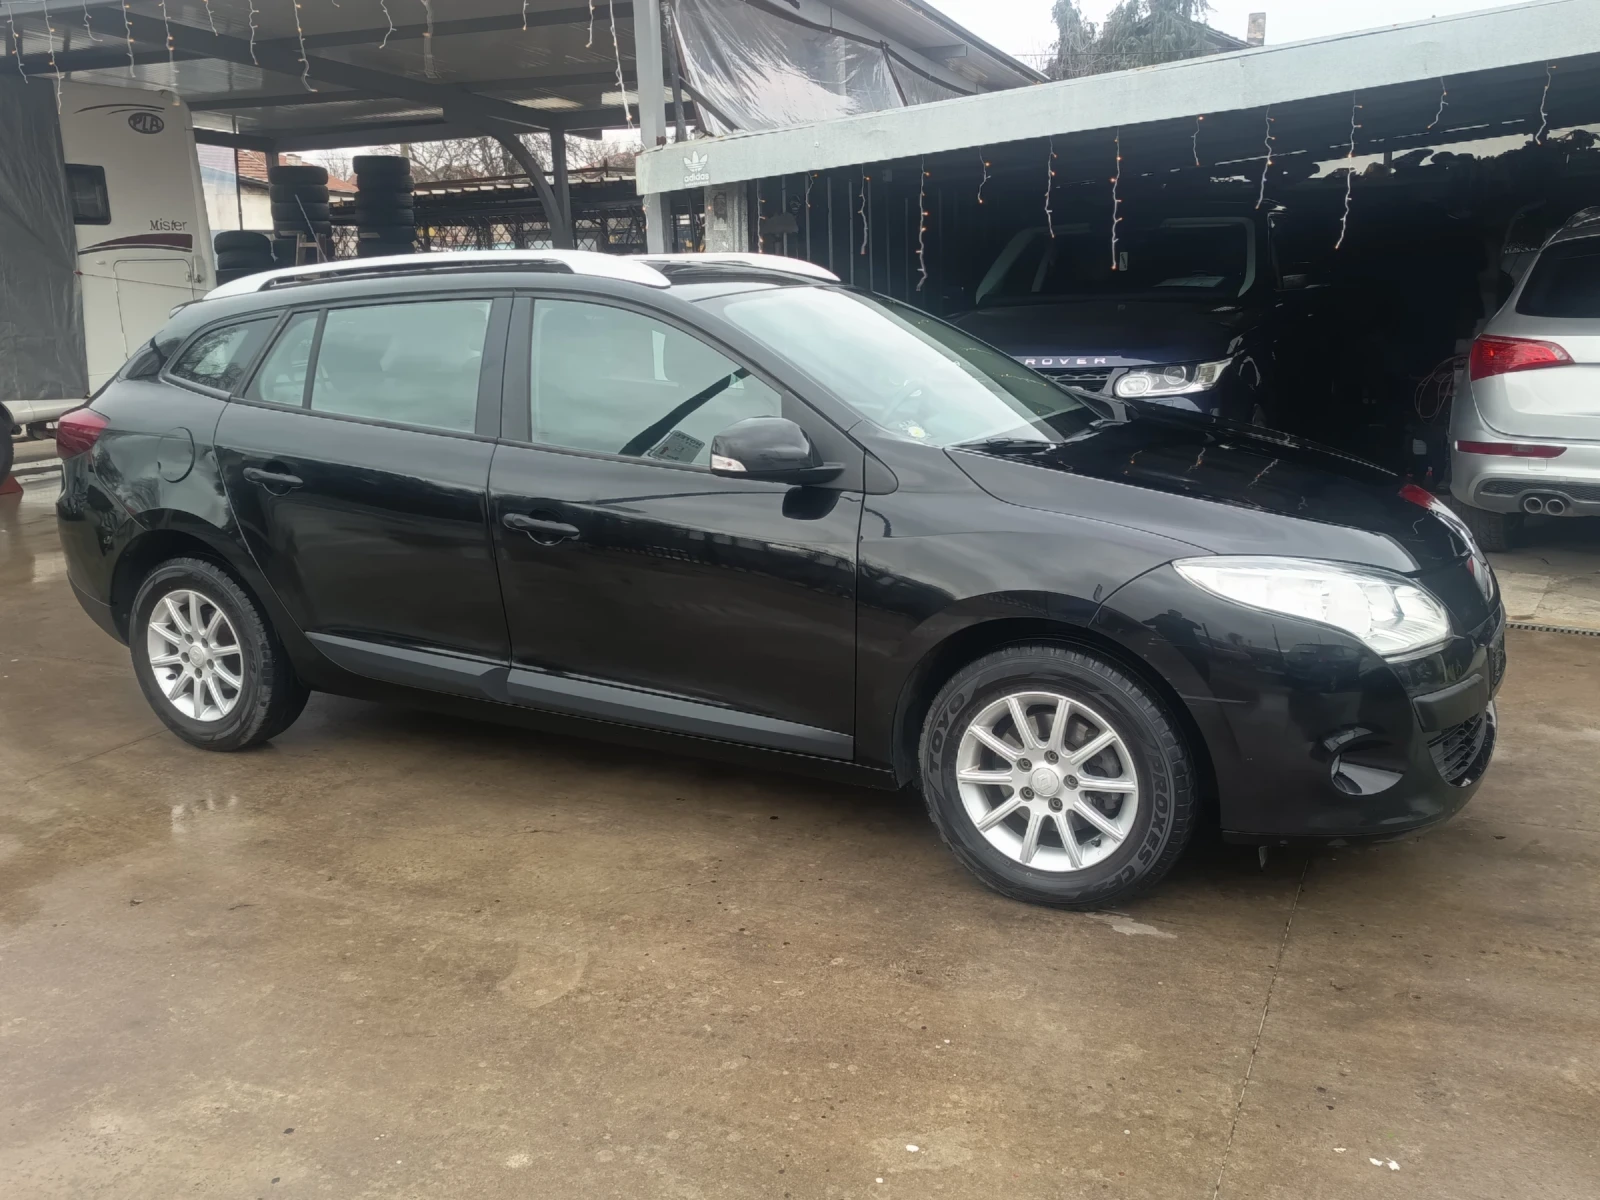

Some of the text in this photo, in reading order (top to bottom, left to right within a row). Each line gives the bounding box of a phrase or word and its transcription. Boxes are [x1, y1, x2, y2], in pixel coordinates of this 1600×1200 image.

[150, 218, 187, 231] Mister
[1024, 357, 1106, 366] ROVER
[928, 692, 965, 774] TOYO
[1137, 753, 1170, 867] PROXES
